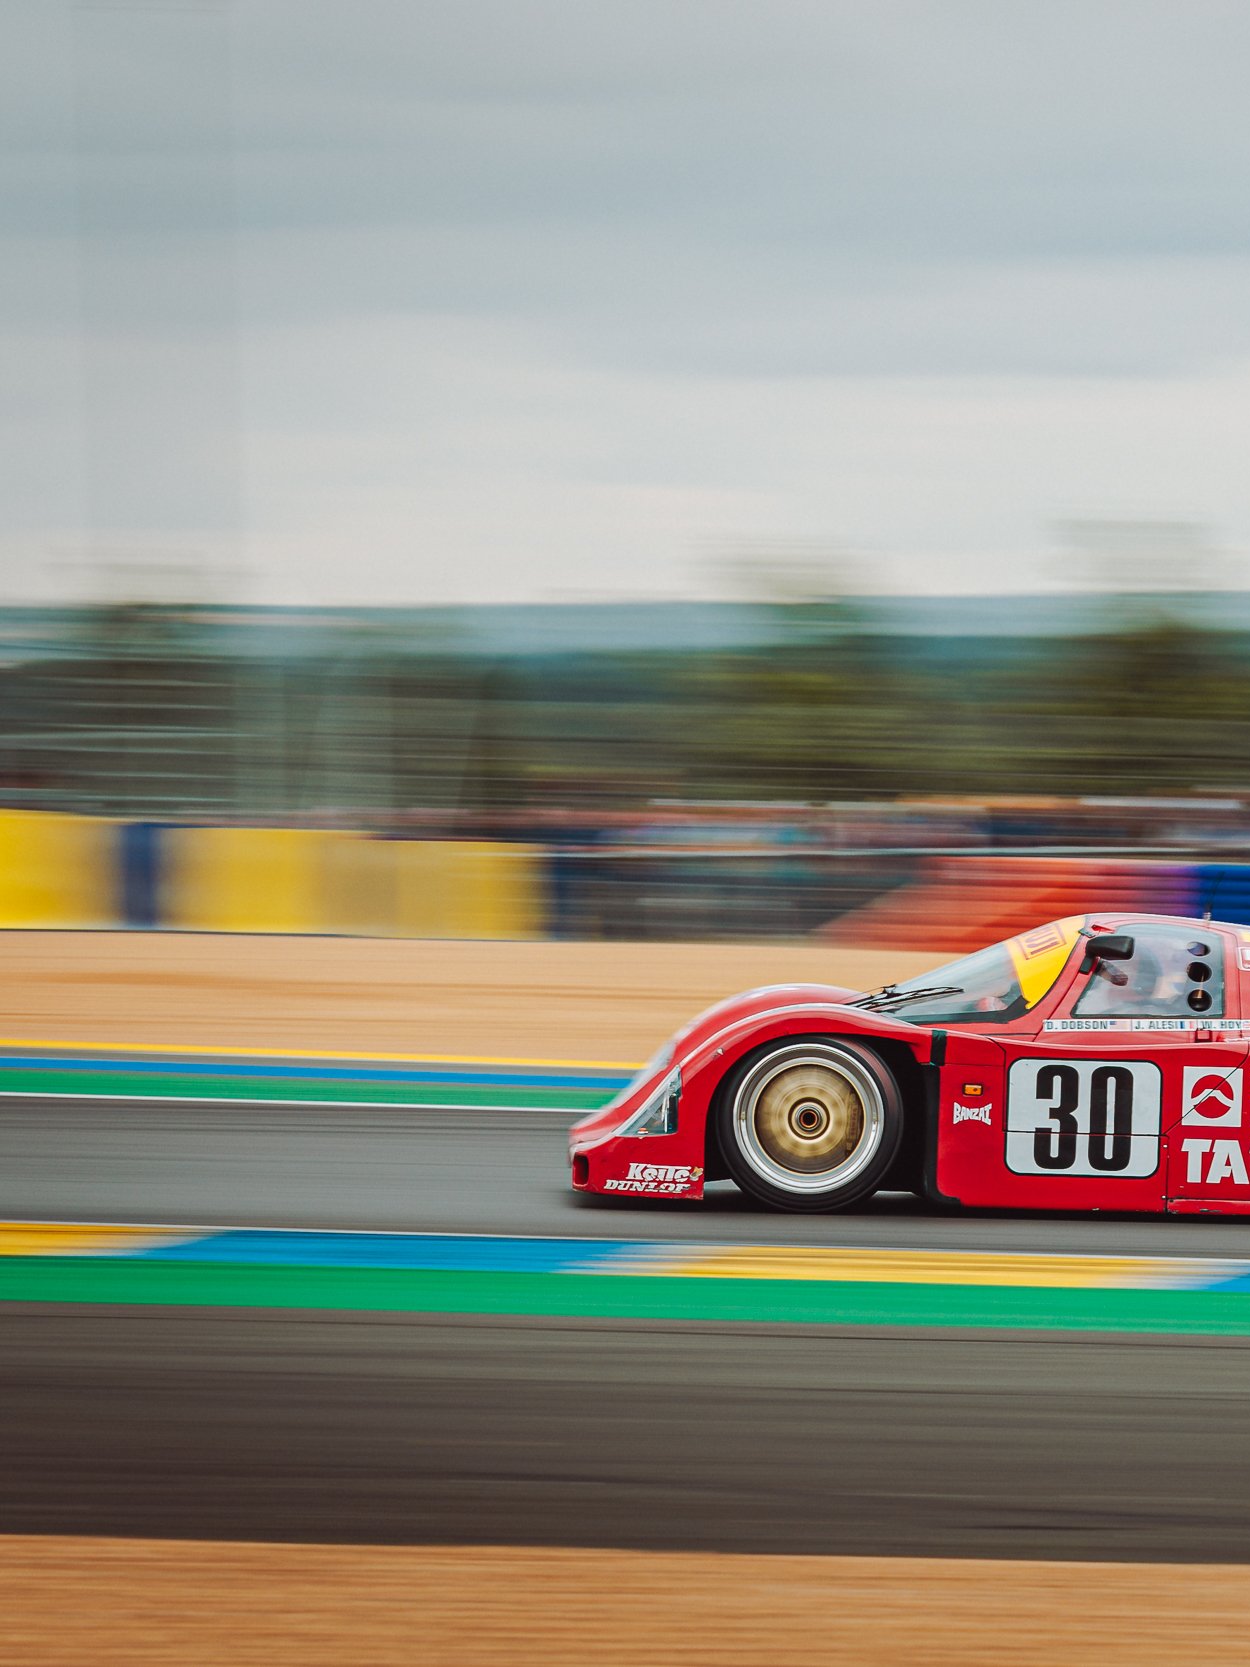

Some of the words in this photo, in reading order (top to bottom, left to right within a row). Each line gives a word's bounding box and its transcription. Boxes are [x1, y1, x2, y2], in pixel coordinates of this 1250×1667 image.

[1046, 1021, 1058, 1030] D.
[1062, 1021, 1108, 1030] DOBSON
[1135, 1021, 1144, 1030] J.
[1149, 1021, 1179, 1030] ALESI
[953, 1101, 992, 1126] BANZAI
[1034, 1064, 1134, 1171] 30
